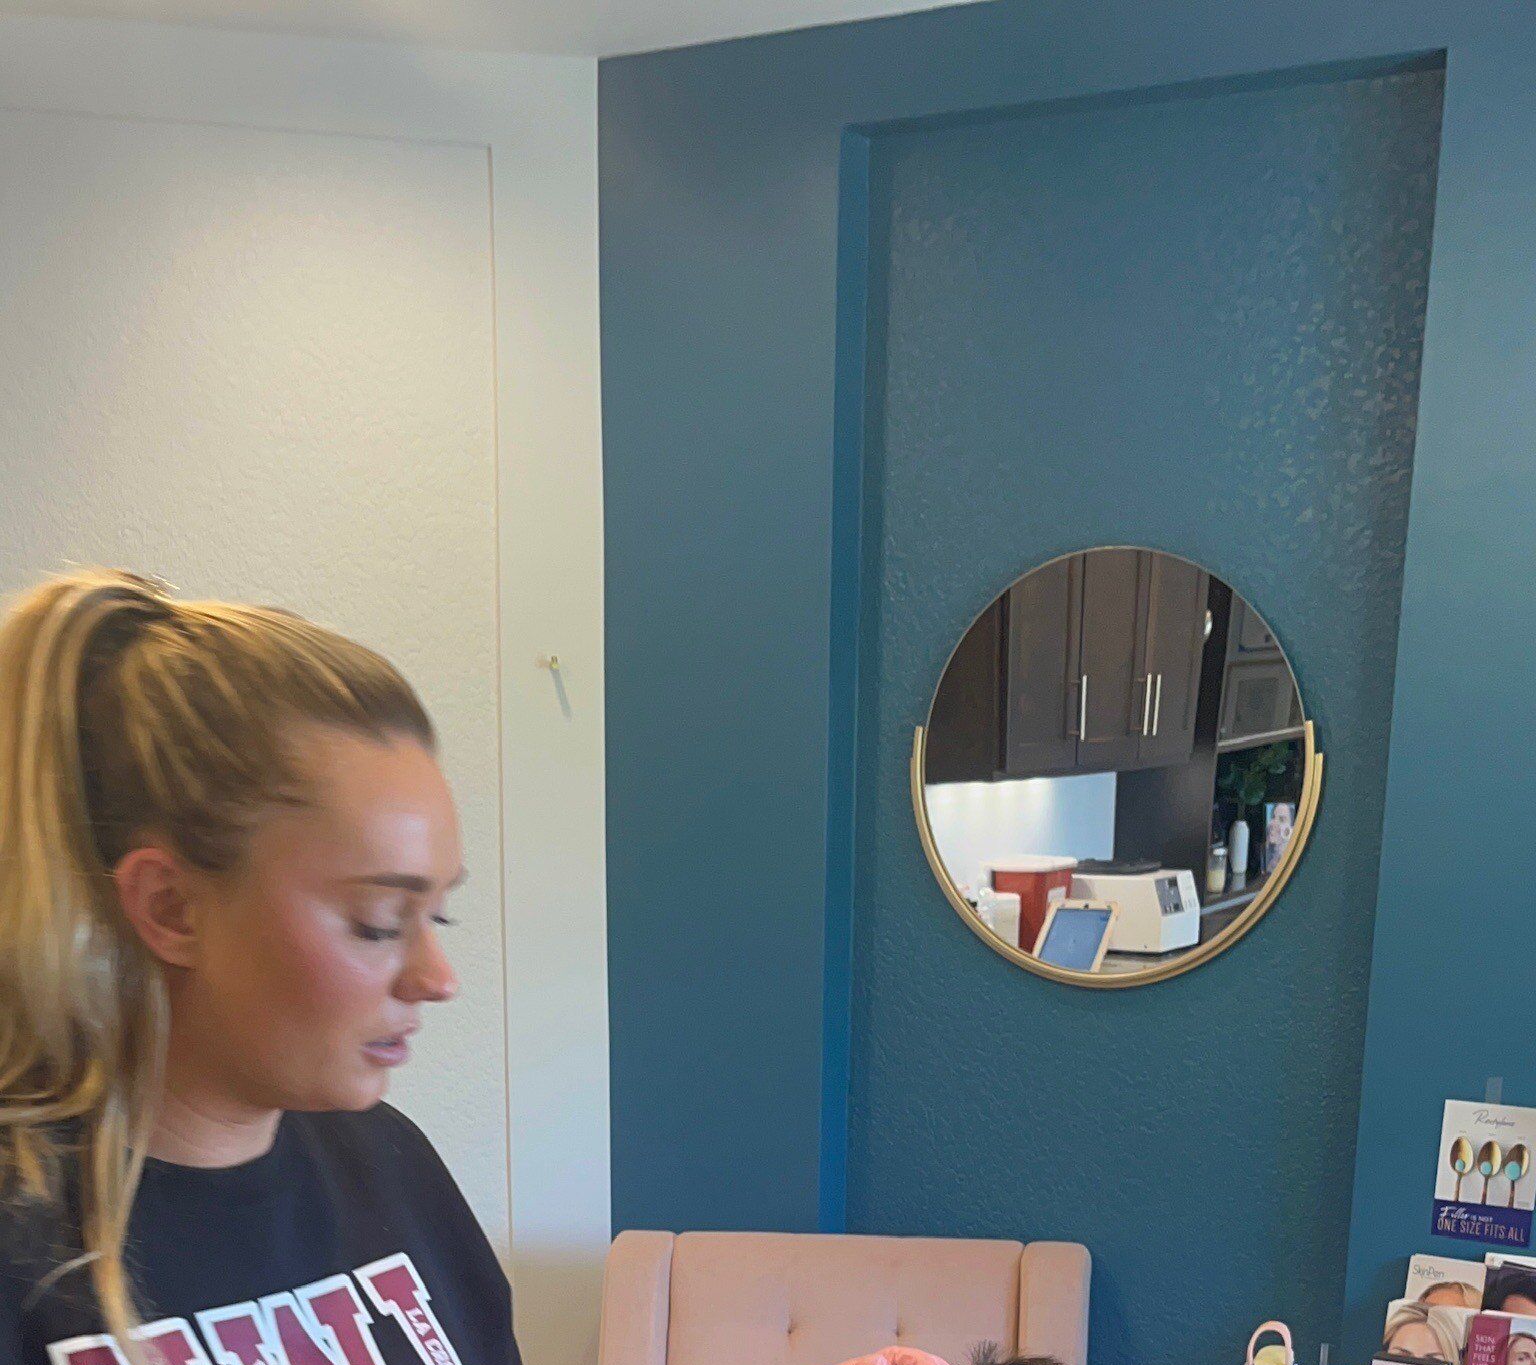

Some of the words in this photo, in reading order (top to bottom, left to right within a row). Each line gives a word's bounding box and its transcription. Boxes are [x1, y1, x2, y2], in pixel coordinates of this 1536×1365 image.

[1437, 1218, 1457, 1233] ONE
[1460, 1220, 1481, 1236] SIZE
[1484, 1223, 1507, 1239] FITS
[1508, 1227, 1526, 1243] ALL
[1411, 1264, 1445, 1280] SkinPen
